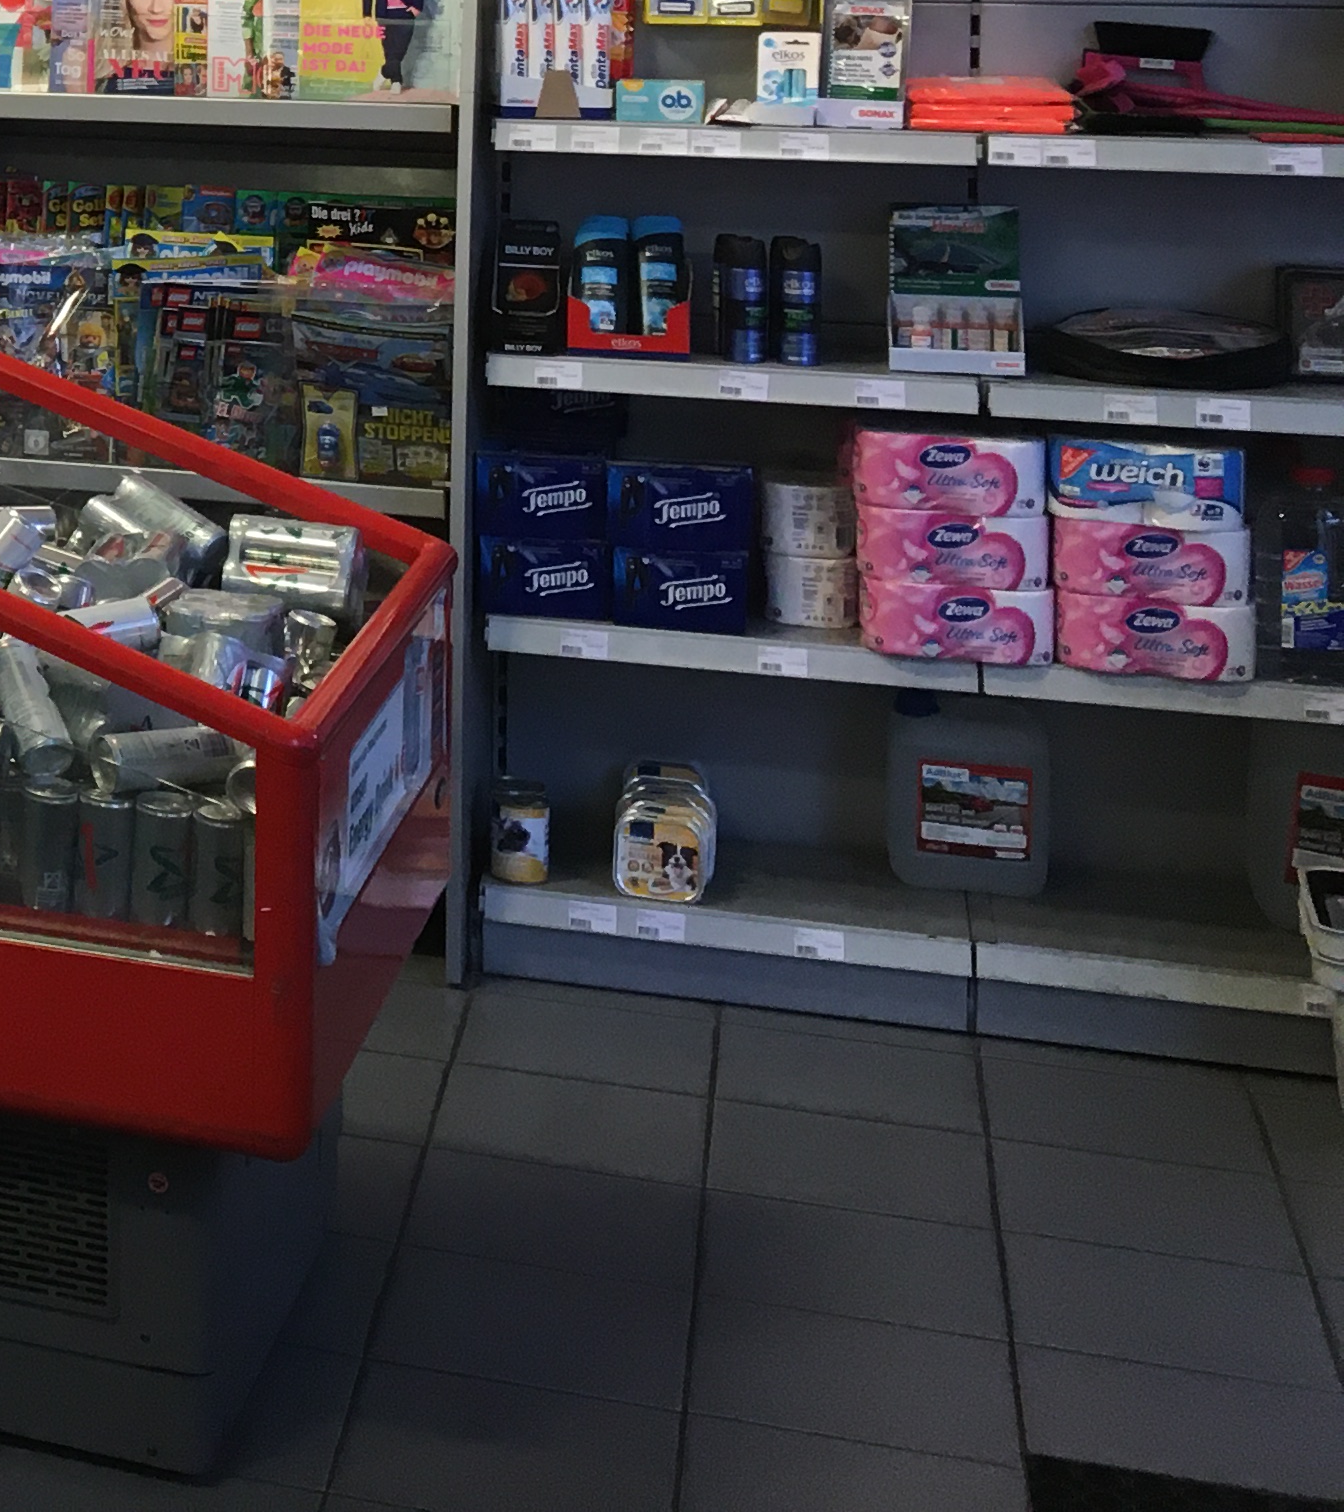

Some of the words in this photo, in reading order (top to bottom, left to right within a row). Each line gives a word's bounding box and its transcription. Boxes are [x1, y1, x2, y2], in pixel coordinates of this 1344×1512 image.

[851, 6, 885, 14] SONAX
[304, 23, 332, 38] DIE
[335, 24, 386, 40] NEUE
[303, 41, 354, 56] MODE
[595, 22, 609, 87] DentaMax
[771, 48, 806, 62] elkos
[302, 58, 334, 73] IST
[338, 60, 367, 73] DA!
[858, 109, 895, 119] SONAX
[312, 206, 327, 220] Die
[330, 207, 352, 222] drei
[504, 245, 530, 256] BILLY
[532, 246, 554, 256] BOY
[343, 260, 438, 288] playmobil
[363, 423, 451, 444] STOPPEN!
[926, 447, 966, 464] Zewa
[928, 473, 963, 488] Ultra
[966, 475, 1002, 492] Soft
[1089, 460, 1184, 488] weich
[524, 486, 588, 512] Tempo
[657, 496, 721, 523] Tempo
[933, 527, 973, 544] Zewa
[1131, 537, 1173, 554] Zewa
[935, 551, 970, 568] Ultra
[974, 553, 1008, 569] Soft
[526, 566, 589, 592] Tempo
[1133, 562, 1170, 579] Ultra
[1173, 565, 1208, 582] Soft
[663, 580, 727, 606] Tempo
[945, 602, 985, 619] Zewa
[1133, 611, 1174, 629] Zewa
[947, 626, 982, 642] Ultra
[991, 628, 1021, 645] Soft
[1134, 637, 1171, 653] Ultra
[1175, 640, 1210, 657] Soft
